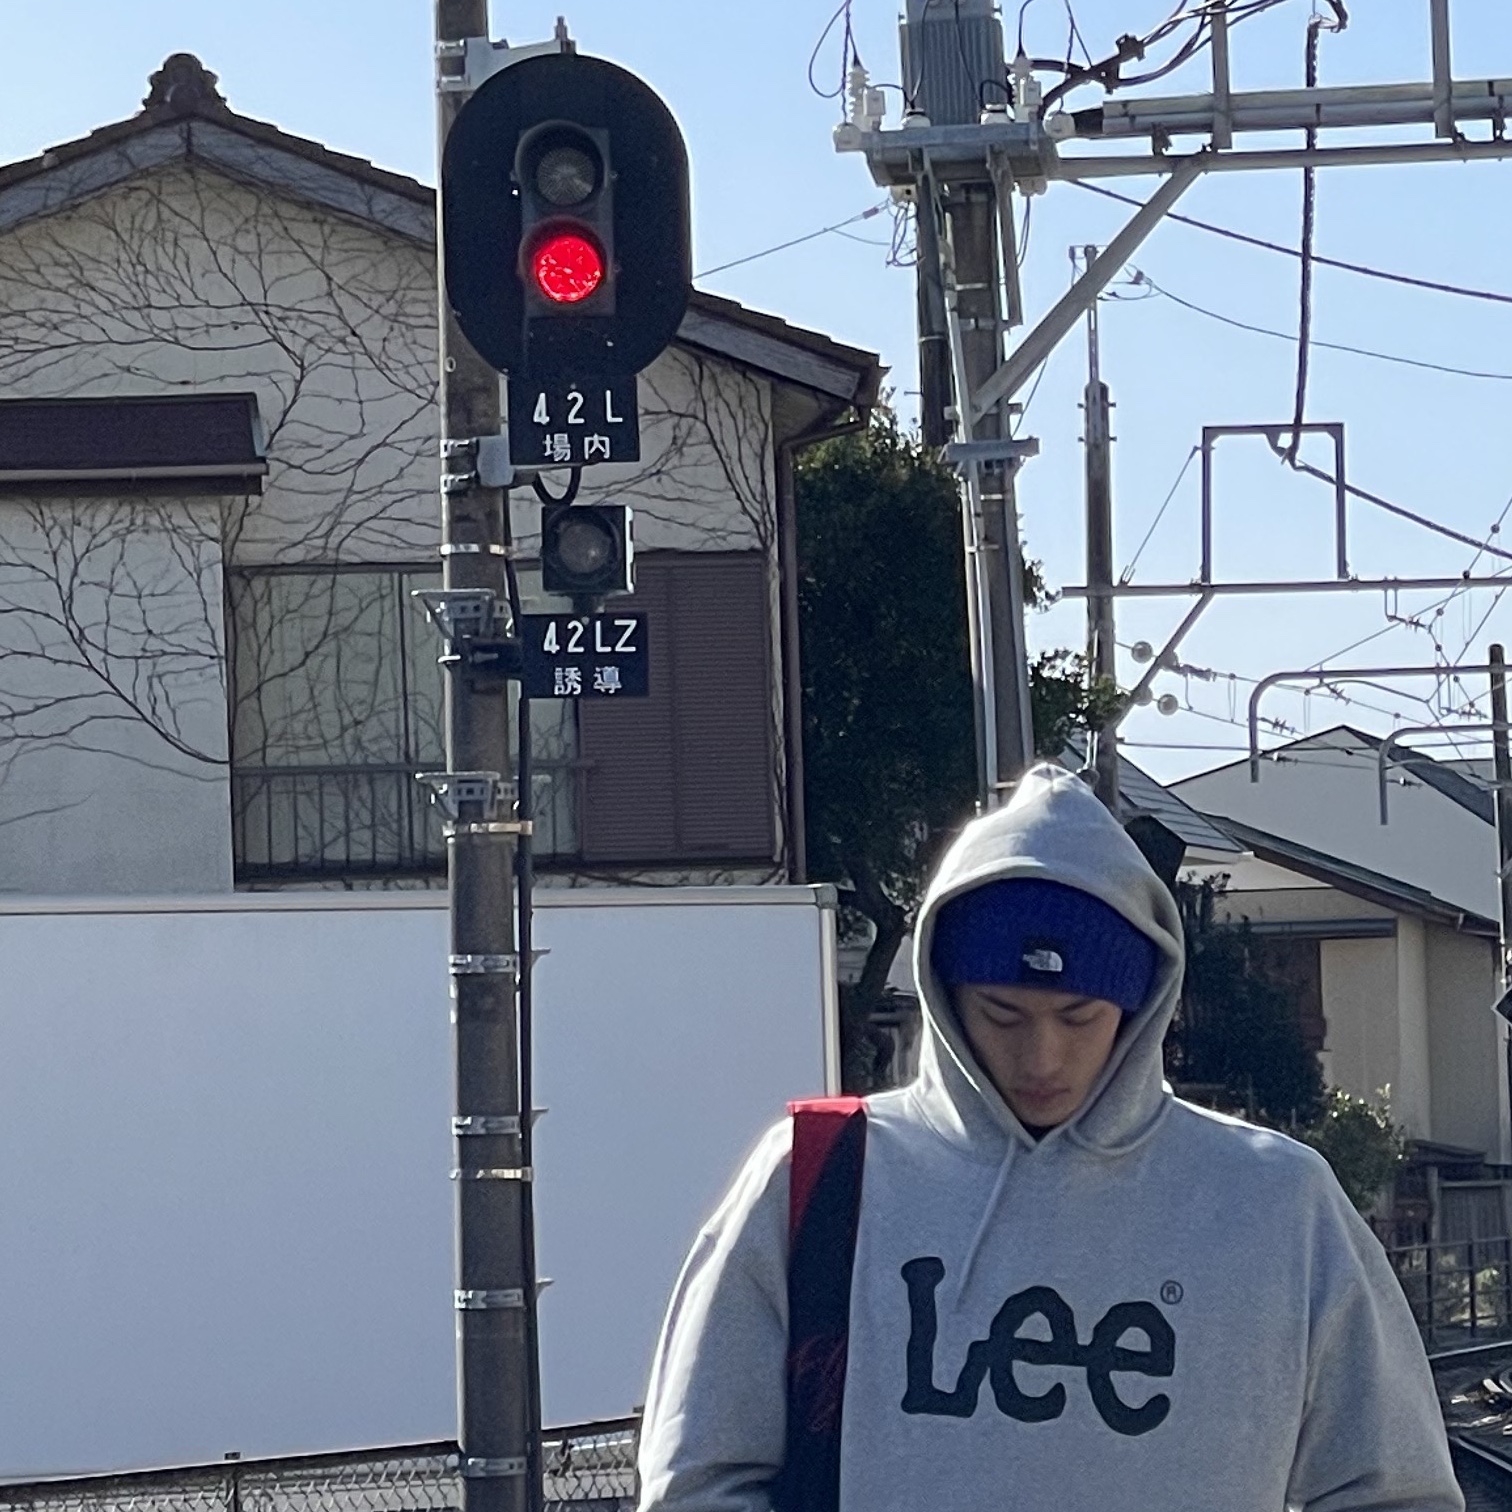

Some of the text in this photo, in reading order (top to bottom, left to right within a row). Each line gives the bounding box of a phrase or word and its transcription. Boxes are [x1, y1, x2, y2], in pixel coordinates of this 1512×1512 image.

[532, 389, 624, 425] 42L
[543, 433, 610, 462] 場内
[543, 619, 638, 654] 42LZ
[553, 665, 623, 696] 誘導
[901, 1256, 1176, 1436] Lee
